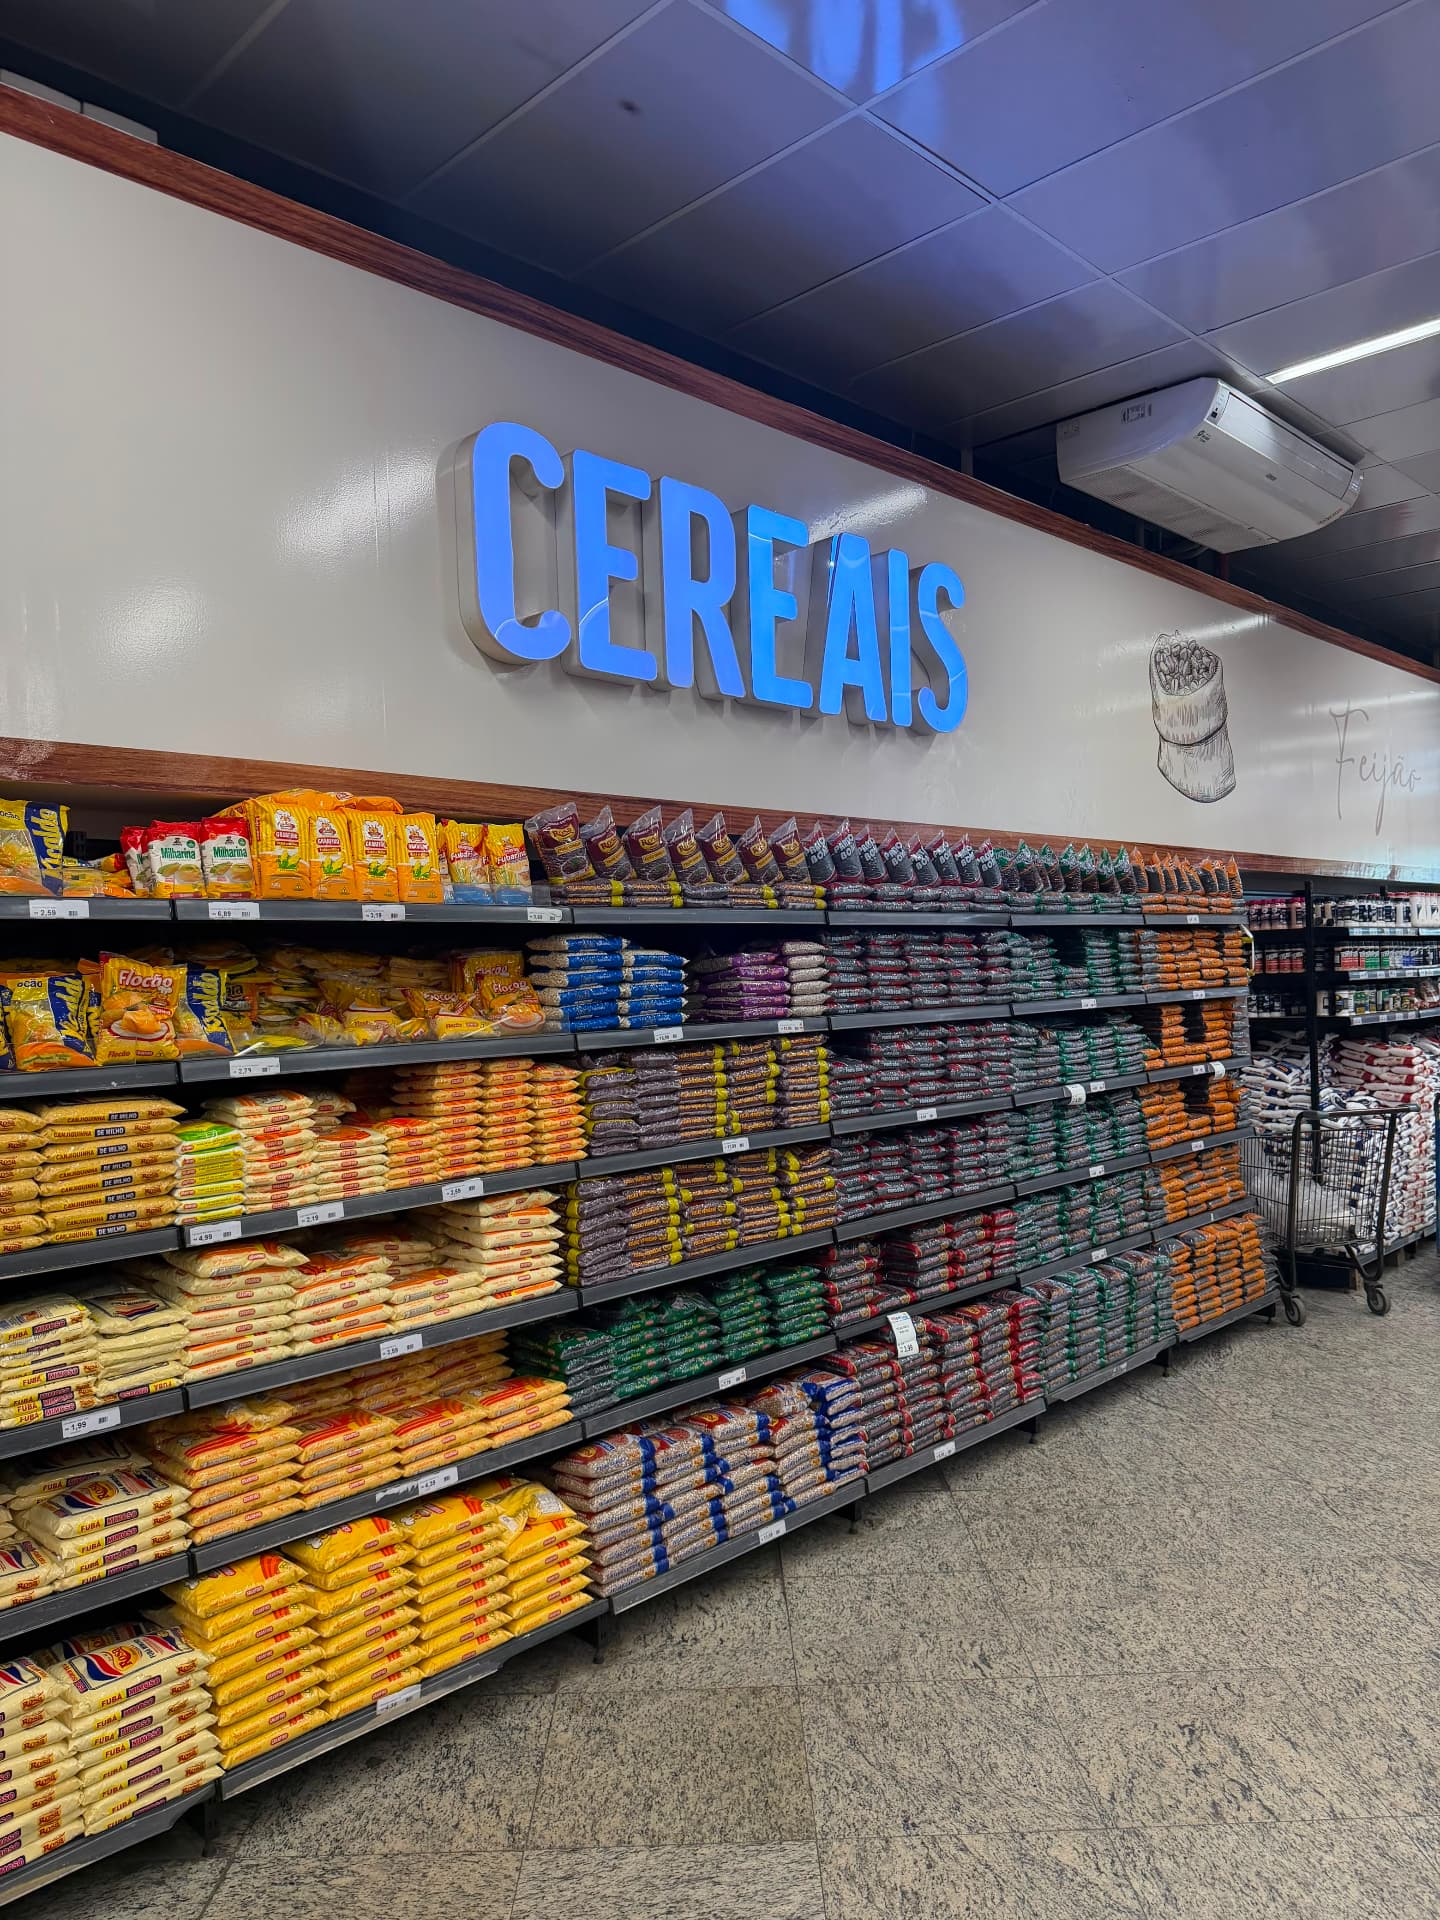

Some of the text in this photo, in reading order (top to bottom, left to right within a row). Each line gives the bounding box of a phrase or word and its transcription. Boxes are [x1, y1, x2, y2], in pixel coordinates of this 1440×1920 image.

[473, 422, 968, 733] CEREAIS
[1329, 699, 1422, 836] Feijão
[161, 847, 196, 860] Milharina
[212, 845, 248, 859] Milharina
[118, 969, 173, 988] Flocão
[67, 1115, 105, 1123] CANJIQUINHA
[105, 1127, 124, 1135] MILHO
[56, 1150, 94, 1160] CANJIQUINHA
[108, 1145, 127, 1153] MILHO
[61, 1183, 99, 1193] CANJIQUINHA
[113, 1177, 131, 1185] MILHO
[64, 1199, 102, 1209] CANJIQUINHA
[116, 1192, 134, 1200] MILHO
[118, 1211, 135, 1219] MILHO
[56, 1230, 93, 1240] CANJIQUINHA
[107, 1225, 126, 1234] MILHO
[8, 1328, 29, 1340] FUBÁ
[22, 1375, 43, 1386] FUBÁ
[47, 1367, 79, 1380] MIMOSO
[20, 1412, 39, 1423] FUBÁ
[45, 1403, 76, 1416] MIMOSO
[71, 1421, 87, 1431] 1,99
[81, 1496, 173, 1532] FUBÁ MIMOSO Rosa
[81, 1541, 101, 1553] FUBÁ
[107, 1527, 138, 1543] MIMOSO
[80, 1561, 99, 1572] FUBÁ
[22, 1691, 45, 1708] Rosa
[101, 1693, 122, 1708] FUBÁ
[127, 1675, 161, 1698] MIMOSO
[96, 1714, 118, 1729] FUBÁ
[122, 1697, 155, 1718] MIMOSO
[94, 1733, 115, 1745] FUBÁ
[120, 1717, 153, 1737] MIMOSO
[23, 1734, 47, 1751] Rosa
[105, 1745, 126, 1758] FUBÁ
[131, 1727, 163, 1748] MIMOSO
[30, 1752, 54, 1770] Rosa
[35, 1769, 58, 1788] Rosa
[102, 1785, 124, 1798] FUBÁ
[112, 1799, 132, 1813] FUBÁ
